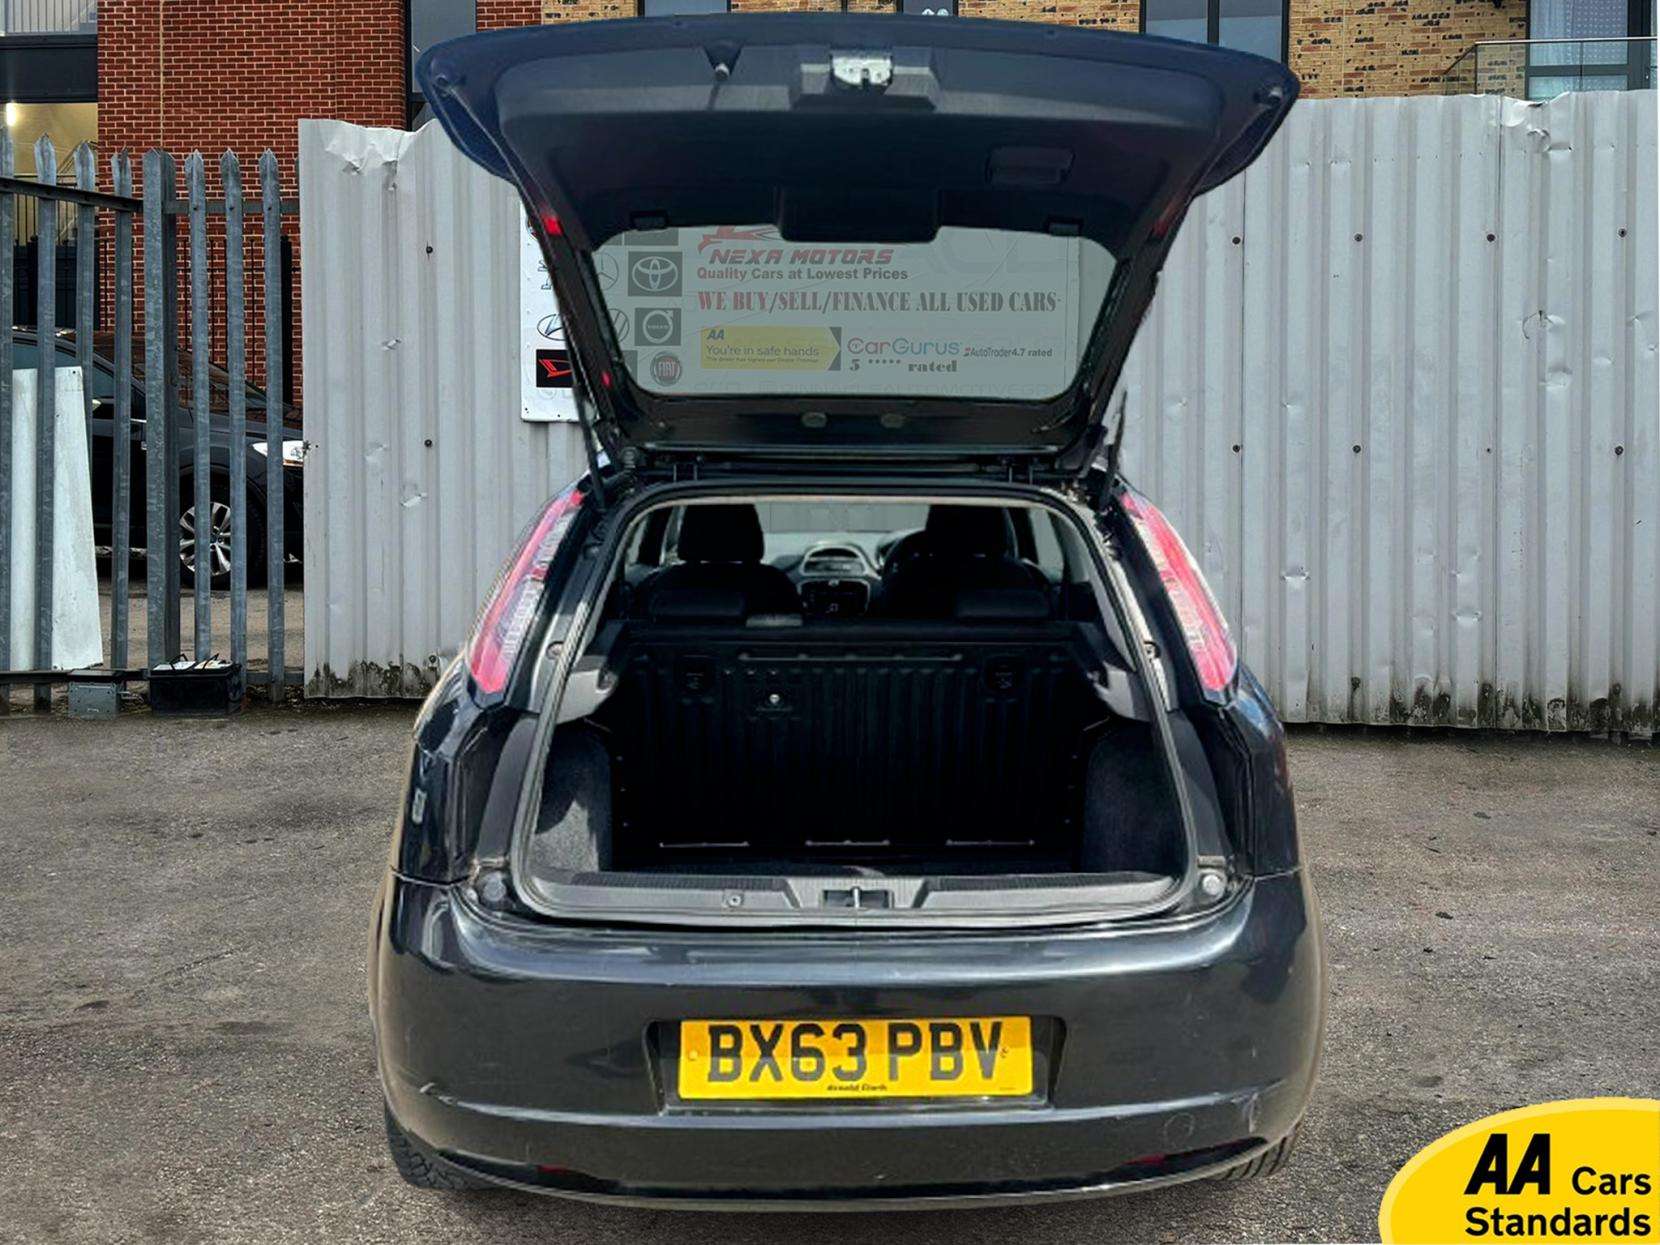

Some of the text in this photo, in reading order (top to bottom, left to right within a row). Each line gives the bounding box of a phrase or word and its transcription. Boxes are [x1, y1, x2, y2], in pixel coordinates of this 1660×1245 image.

[710, 249, 894, 264] NEXA MOTORS
[697, 267, 908, 281] Quality Cars at Lowest Prices
[698, 291, 727, 311] WE
[917, 291, 950, 311] ALL
[957, 291, 1003, 311] USED
[1009, 291, 1057, 311] CARS
[707, 329, 725, 340] AA
[706, 345, 820, 356] You're in safe hands
[847, 337, 961, 355] CarGurus
[1028, 347, 1053, 357] rated
[850, 359, 958, 373] 5 rated
[708, 1021, 1002, 1082] BX63 PBV
